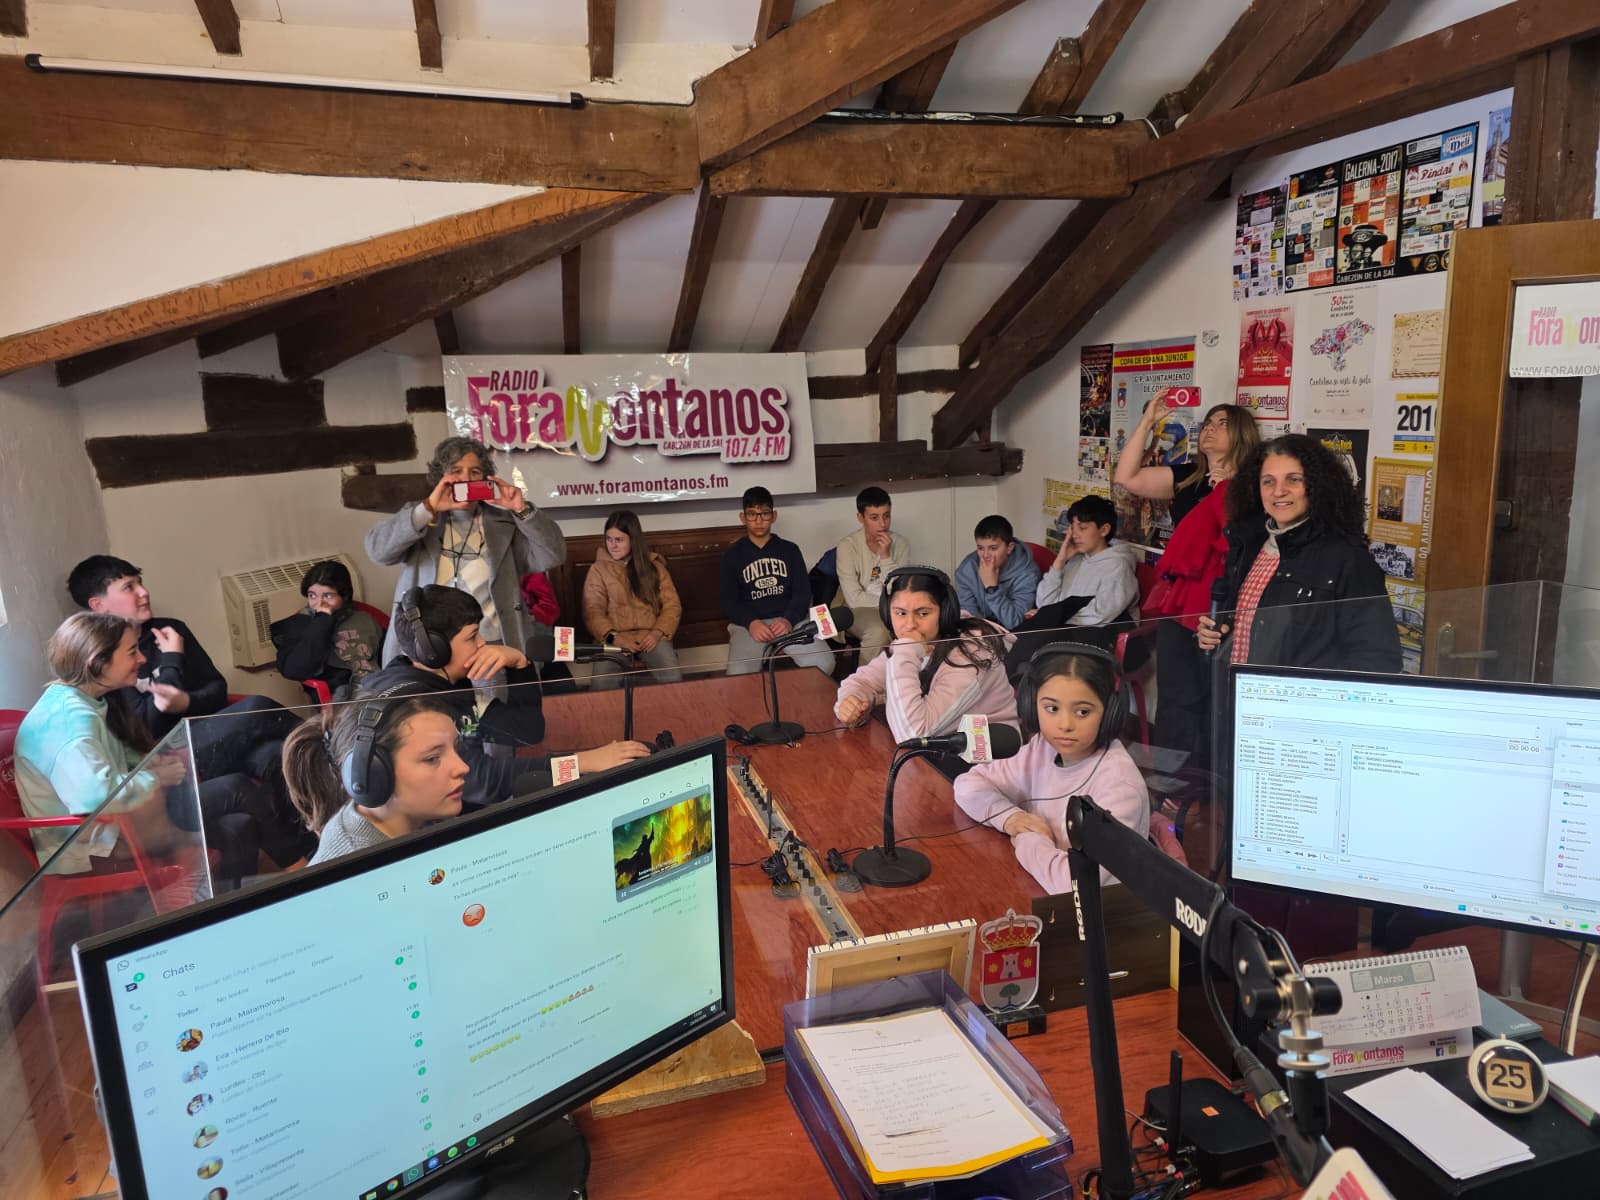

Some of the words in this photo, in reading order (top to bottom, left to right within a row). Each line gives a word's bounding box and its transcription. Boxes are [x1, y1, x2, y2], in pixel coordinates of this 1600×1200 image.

[1345, 151, 1399, 181] GALERNA-2017
[1166, 353, 1188, 362] JUNIOR
[490, 370, 539, 391] RADIO
[1397, 405, 1438, 431] 201
[693, 440, 701, 448] DE
[702, 439, 711, 447] LA
[726, 438, 760, 457] 107.4
[765, 436, 786, 455] FM
[557, 474, 729, 497] www.foramontanos.fm
[743, 558, 788, 583] UNITED
[751, 585, 784, 600] COLORS
[162, 961, 196, 980] Chats
[1490, 1064, 1526, 1089] 25
